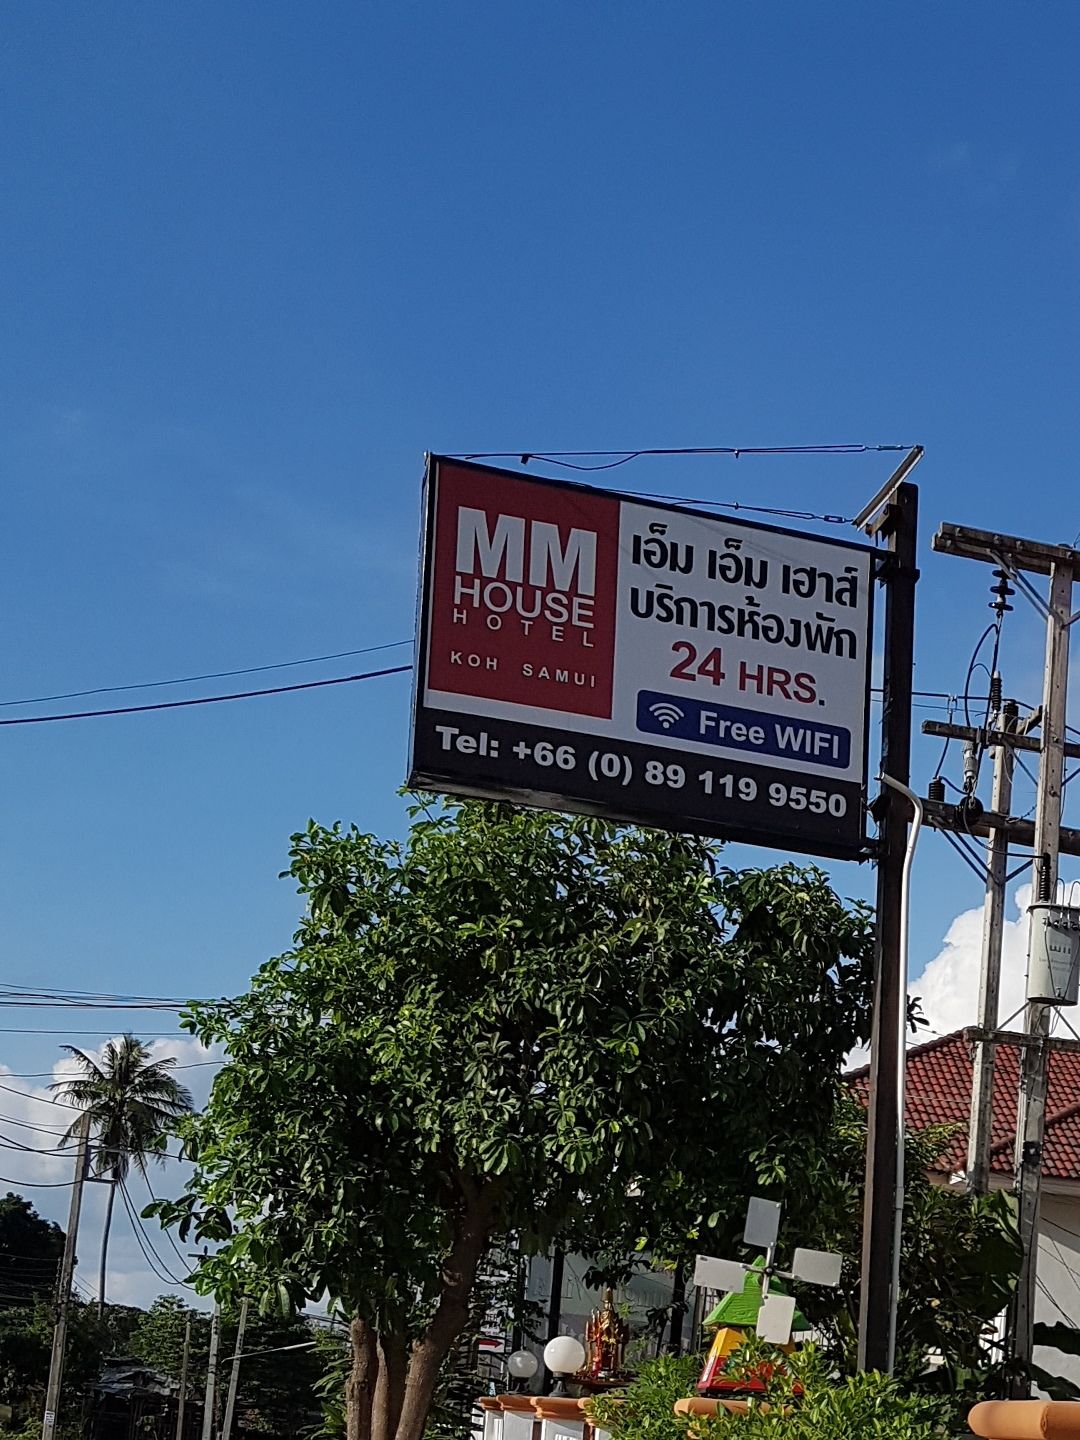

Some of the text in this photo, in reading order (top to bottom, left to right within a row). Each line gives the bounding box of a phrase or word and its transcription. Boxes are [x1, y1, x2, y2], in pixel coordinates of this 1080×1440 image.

[455, 505, 598, 597] MM
[631, 523, 859, 609] เอ็ม เอ็ม เฮาส์
[453, 575, 595, 629] HOUSE
[453, 608, 595, 649] HOTEL
[630, 583, 858, 661] บริการห้องพัก
[450, 650, 596, 689] KOH SAMUI
[669, 640, 826, 707] 24 HRS.
[699, 711, 840, 760] Free WIFI
[435, 725, 848, 819] Tel: +66 (0) 89 119 9550
